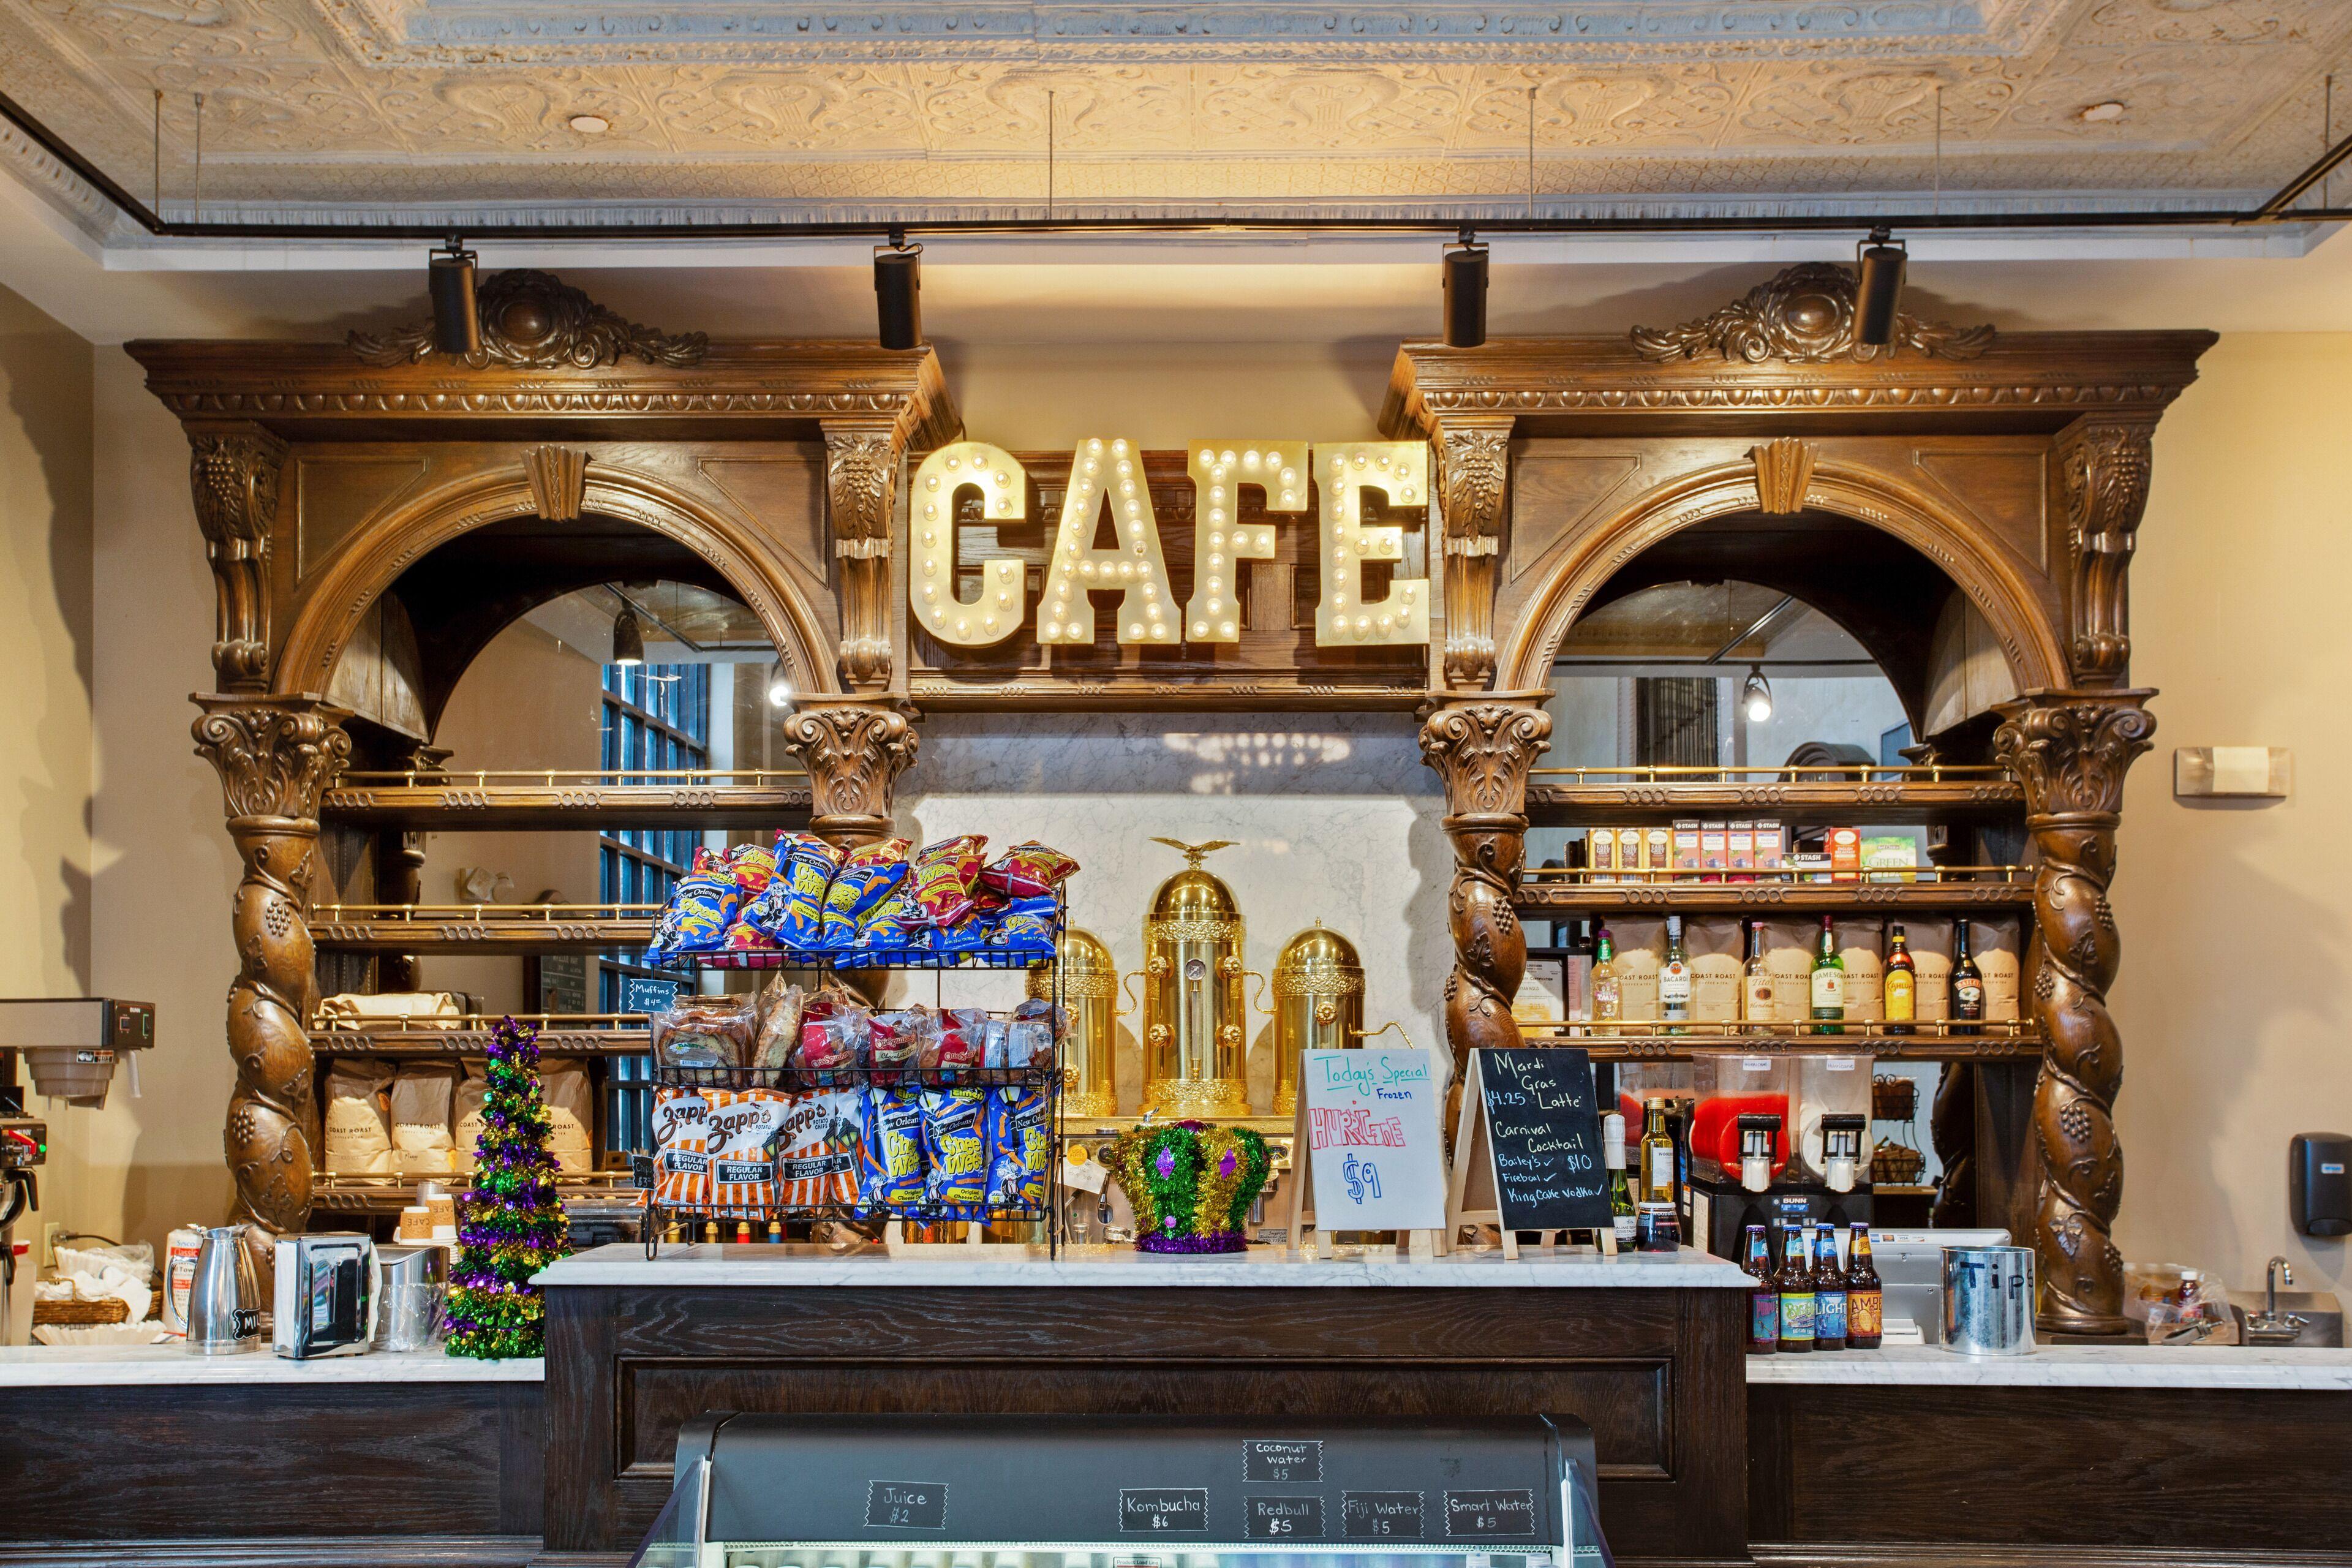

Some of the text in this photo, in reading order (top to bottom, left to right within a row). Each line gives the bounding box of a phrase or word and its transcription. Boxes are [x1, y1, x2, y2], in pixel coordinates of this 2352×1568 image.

[910, 438, 1430, 647] CAFE
[793, 855, 808, 864] New
[1869, 858, 1908, 867] GREEN
[680, 888, 720, 901] New Orleans
[1751, 978, 1774, 987] Tito's
[1957, 978, 1980, 990] BAILEY
[635, 985, 669, 995] Muffins
[881, 1051, 907, 1060] Chocolate
[944, 1051, 959, 1060] Otis
[812, 1058, 825, 1068] Otis
[1493, 1050, 1545, 1079] Mardi
[1313, 1054, 1427, 1096] Today's Special
[1521, 1075, 1557, 1096] Gras
[1376, 1088, 1412, 1099] Frozen
[1485, 1087, 1526, 1115] $4.25
[658, 1106, 707, 1145] Zapp
[895, 1117, 919, 1126] Orlean
[935, 1125, 948, 1136] New
[949, 1118, 972, 1131] Orleans
[1017, 1119, 1031, 1128] New
[1495, 1121, 1551, 1138] Carnival
[940, 1134, 981, 1156] Chee
[1528, 1133, 1584, 1154] Cocktail
[672, 1154, 707, 1165] REGULAR
[793, 1161, 826, 1169] REGULAR
[1498, 1153, 1593, 1174] Bailey's $10
[636, 1162, 652, 1176] Chips
[674, 1163, 704, 1172] FLAVOR
[795, 1168, 824, 1177] FLAVOR
[1343, 1153, 1382, 1205] $9
[1501, 1172, 1540, 1183] Fireball
[174, 1248, 198, 1257] Classic
[1959, 1262, 2034, 1300] Tips
[1815, 1302, 1847, 1315] LIGHT
[1852, 1296, 1882, 1314] AMBE
[244, 1314, 260, 1330] MIL
[1256, 1442, 1307, 1454] Coconut
[1273, 1466, 1289, 1480] $5
[884, 1487, 927, 1505] Juice
[1126, 1497, 1200, 1513] Kombucha
[1257, 1502, 1309, 1516] Redbull
[1348, 1499, 1419, 1519] Fiji Water
[1449, 1498, 1534, 1512] Smart Water
[889, 1507, 910, 1524] $2
[1152, 1513, 1169, 1529] $6
[1476, 1515, 1497, 1529] $5
[1268, 1518, 1292, 1535] $5
[1371, 1518, 1390, 1534] $5
